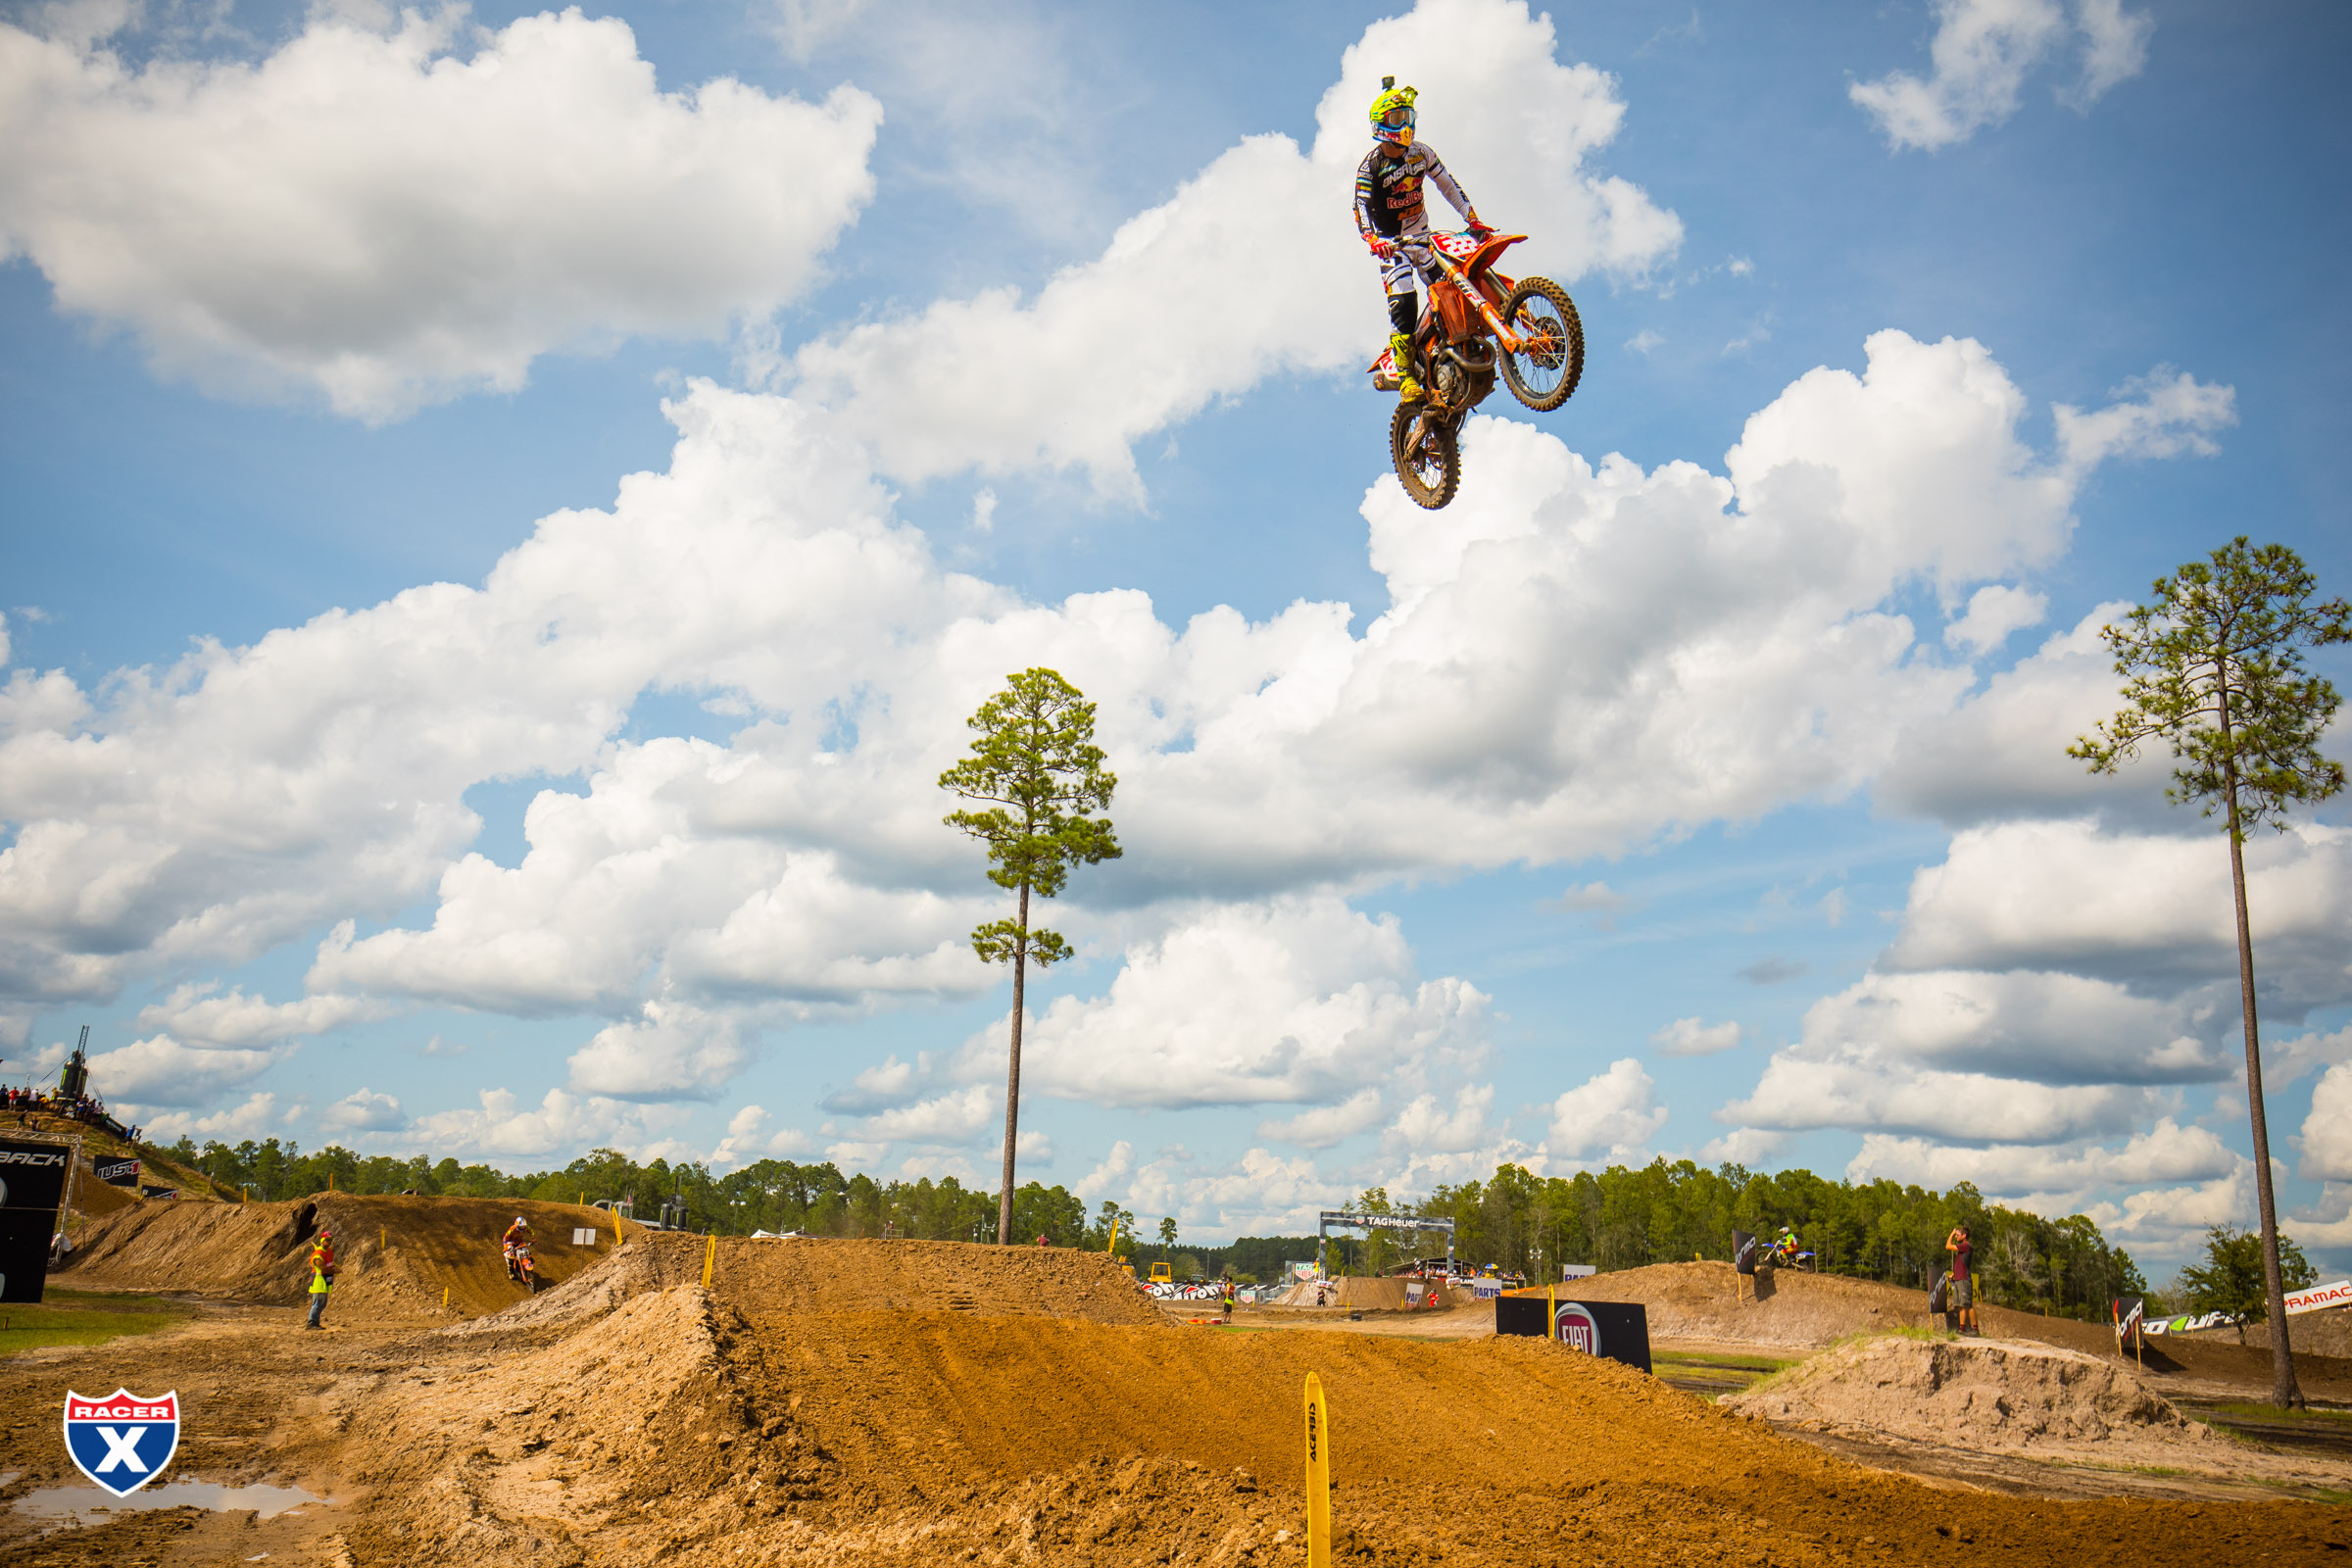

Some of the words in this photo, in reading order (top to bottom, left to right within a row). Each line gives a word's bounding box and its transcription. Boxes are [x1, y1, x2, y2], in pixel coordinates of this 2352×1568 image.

[1387, 193, 1411, 209] Red
[1443, 236, 1478, 257] 222
[1474, 1287, 1500, 1298] PARTS
[1562, 1325, 1589, 1354] FIAT
[1308, 1402, 1317, 1462] ACERBIS
